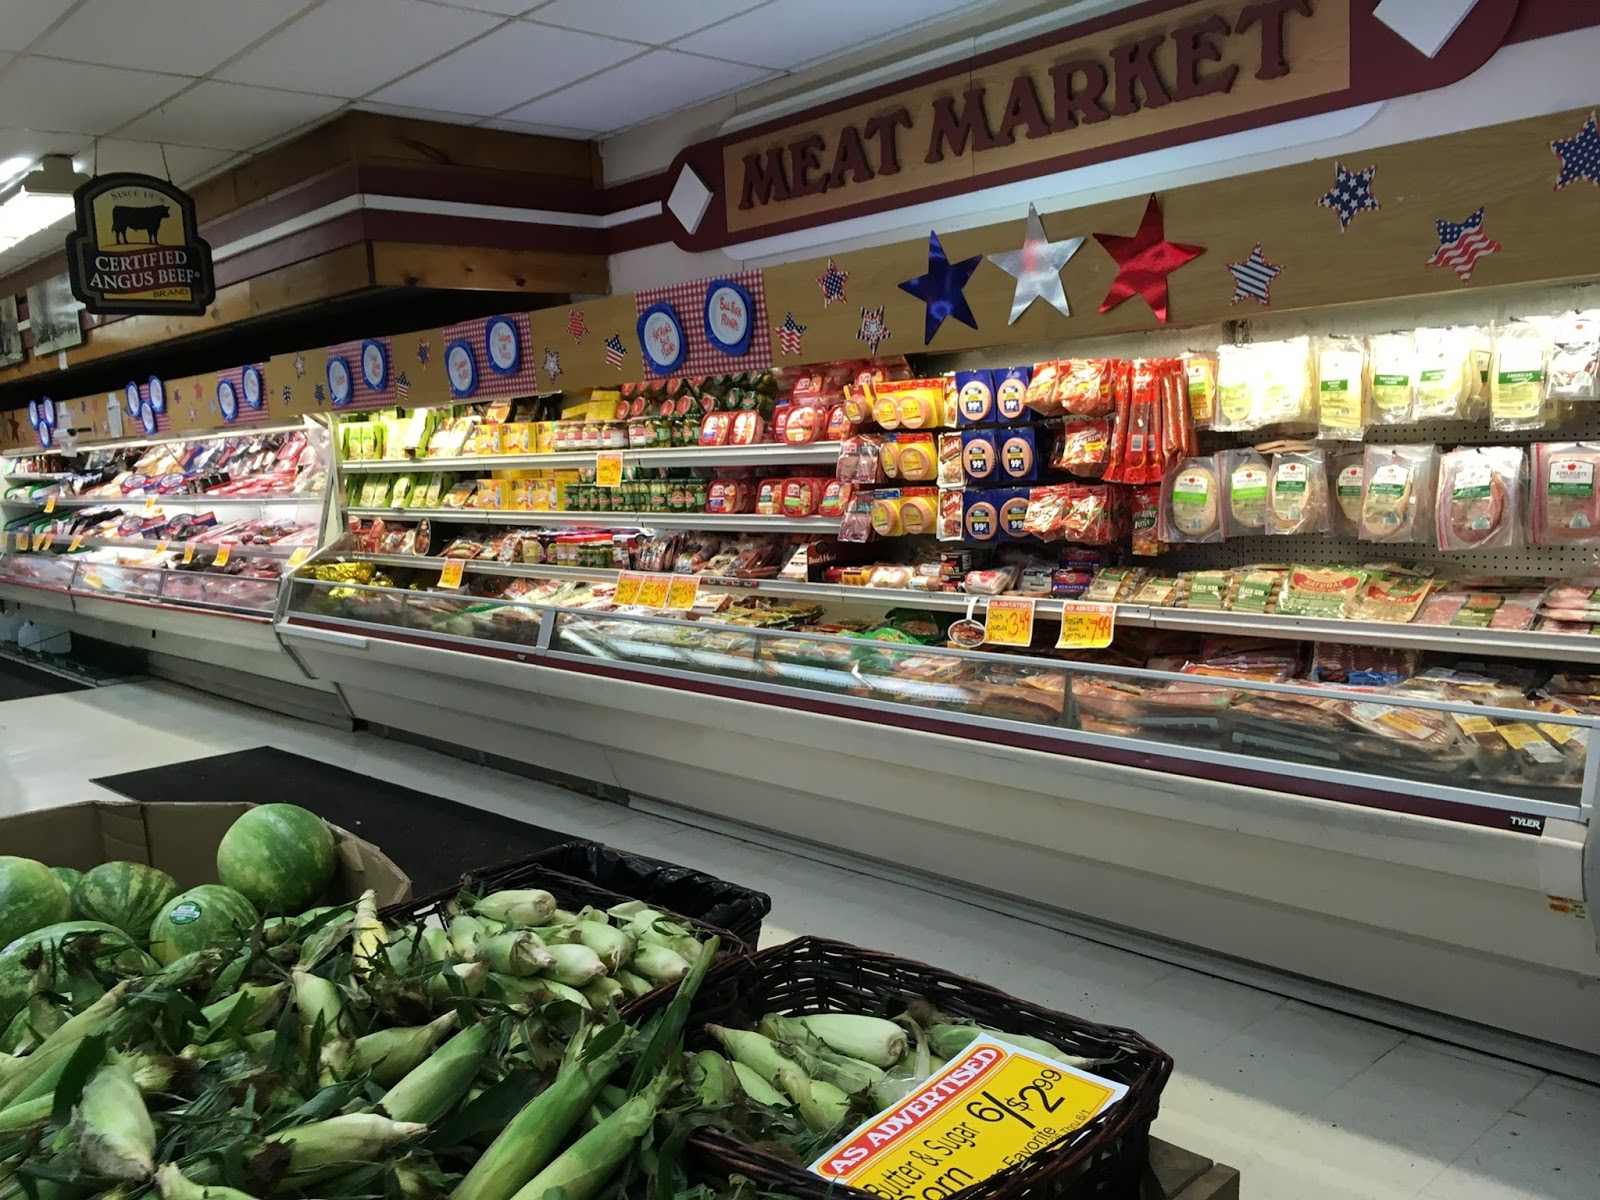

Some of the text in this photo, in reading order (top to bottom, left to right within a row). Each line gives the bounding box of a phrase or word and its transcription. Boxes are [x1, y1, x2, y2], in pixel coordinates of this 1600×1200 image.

[738, 0, 1313, 211] MEAT MARKET
[110, 190, 138, 201] SINCE
[95, 250, 187, 271] CERTIFIED
[90, 271, 154, 289] ANGUS
[153, 289, 189, 298] BRAND
[1075, 605, 1114, 613] ADVERTISED
[1510, 816, 1542, 830] TYLER
[829, 1048, 998, 1174] AS ADVERTISED
[923, 1121, 981, 1156] Sugar
[1002, 1126, 1057, 1166] Favorite
[909, 1150, 943, 1166] &
[862, 1160, 927, 1200] Butter
